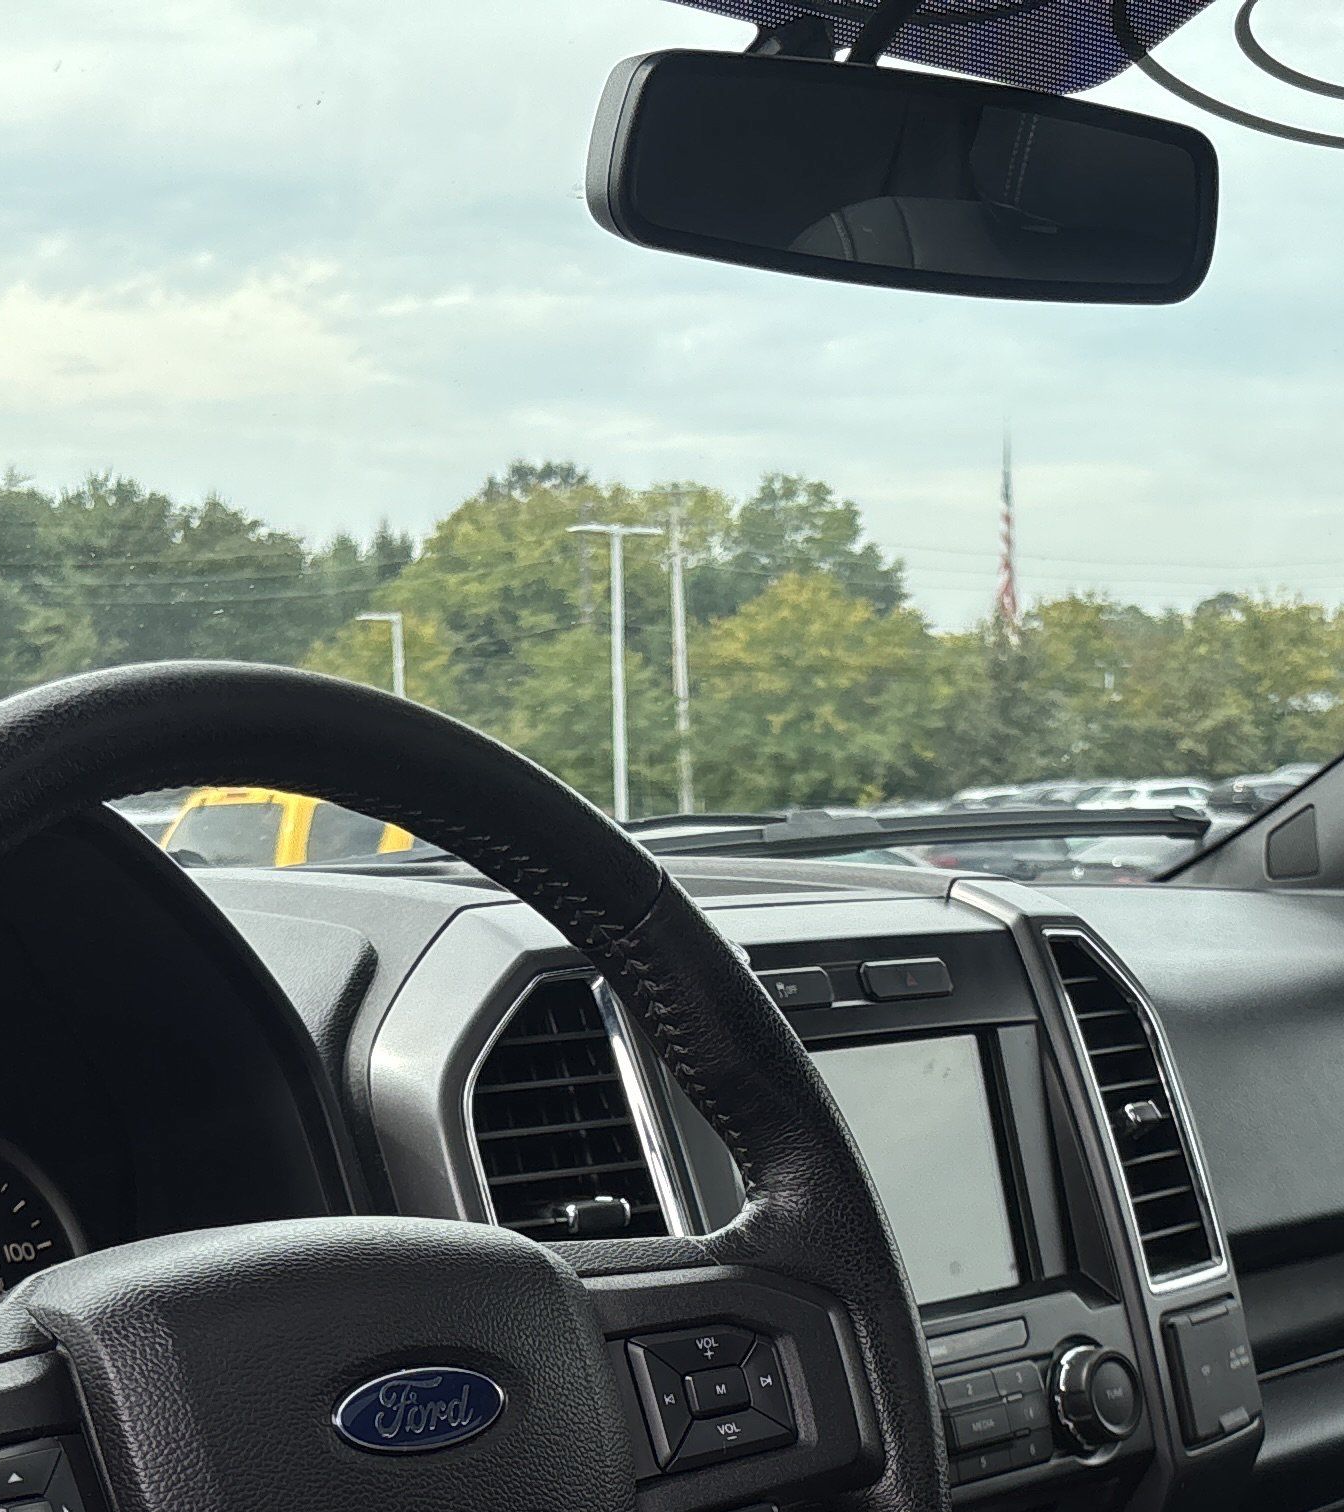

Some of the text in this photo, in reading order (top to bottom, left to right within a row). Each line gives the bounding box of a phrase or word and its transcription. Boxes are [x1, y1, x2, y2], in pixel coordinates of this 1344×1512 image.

[2, 1242, 36, 1263] 100
[695, 1337, 719, 1351] VOL
[715, 1383, 727, 1397] M
[374, 1377, 475, 1439] Ford
[716, 1421, 741, 1437] VOL
[971, 1416, 996, 1433] MEDIA
